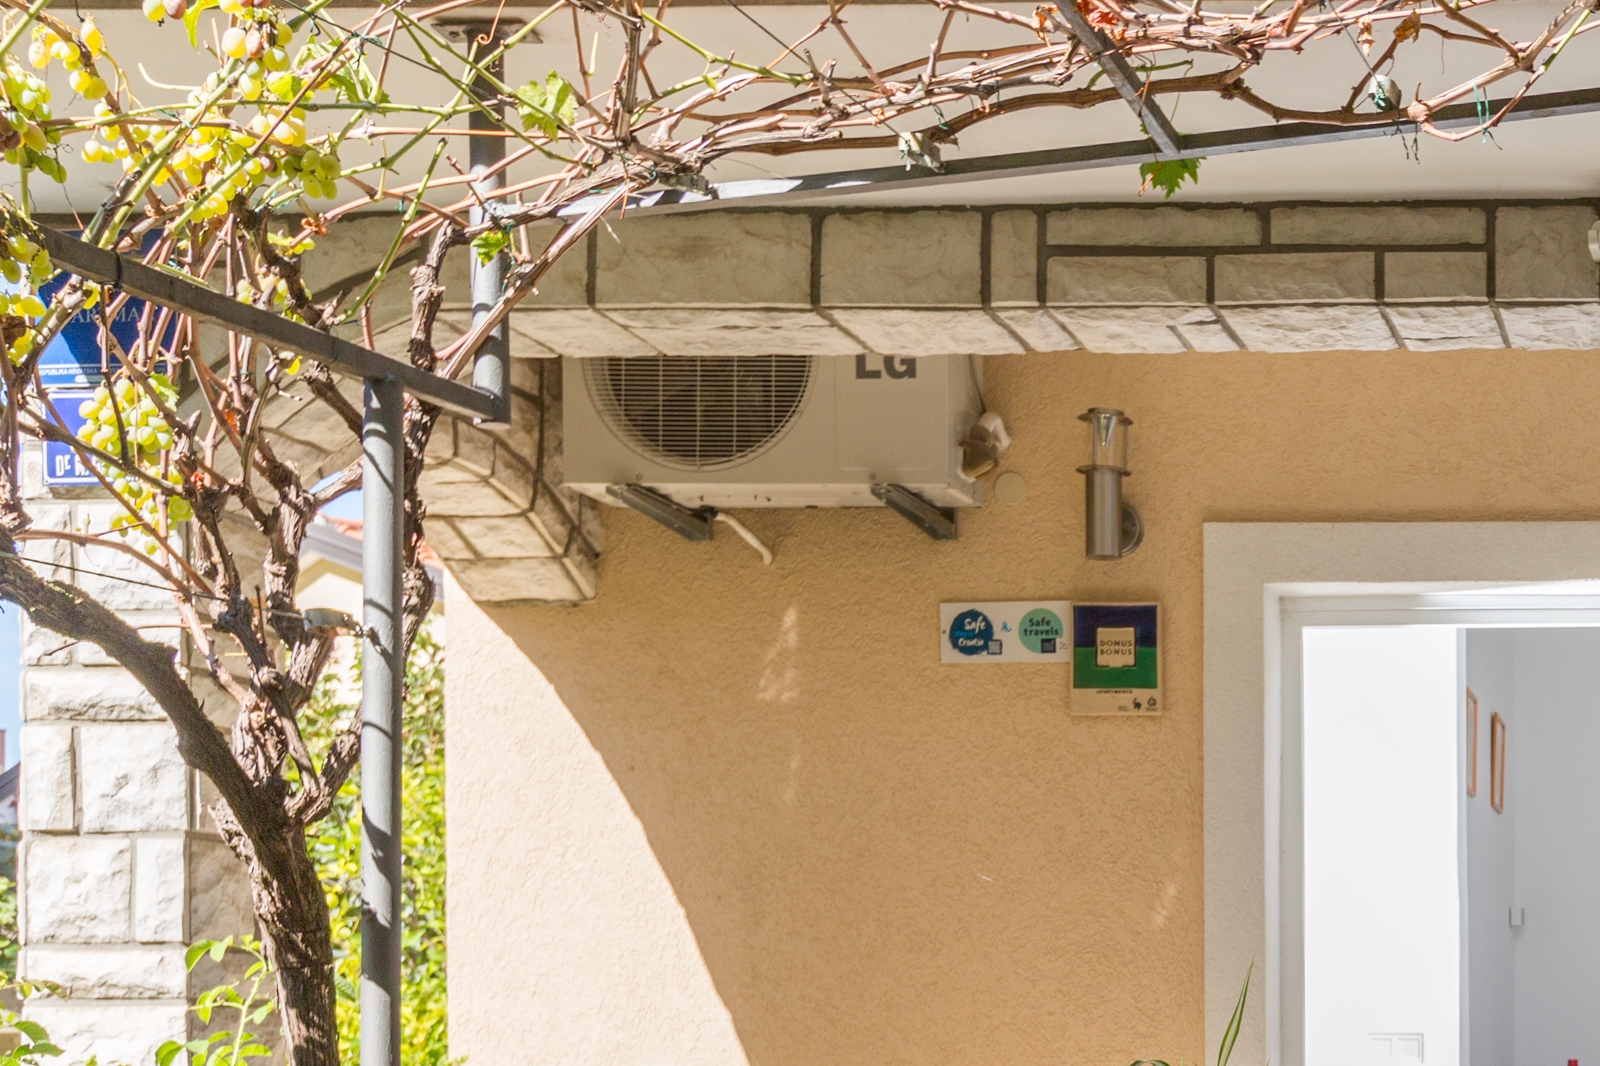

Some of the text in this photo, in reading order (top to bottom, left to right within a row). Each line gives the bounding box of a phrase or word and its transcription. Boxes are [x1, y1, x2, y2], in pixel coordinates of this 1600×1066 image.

[855, 354, 917, 379] LG
[964, 615, 986, 634] Safe
[1029, 617, 1051, 627] Safe
[1024, 626, 1059, 636] travels
